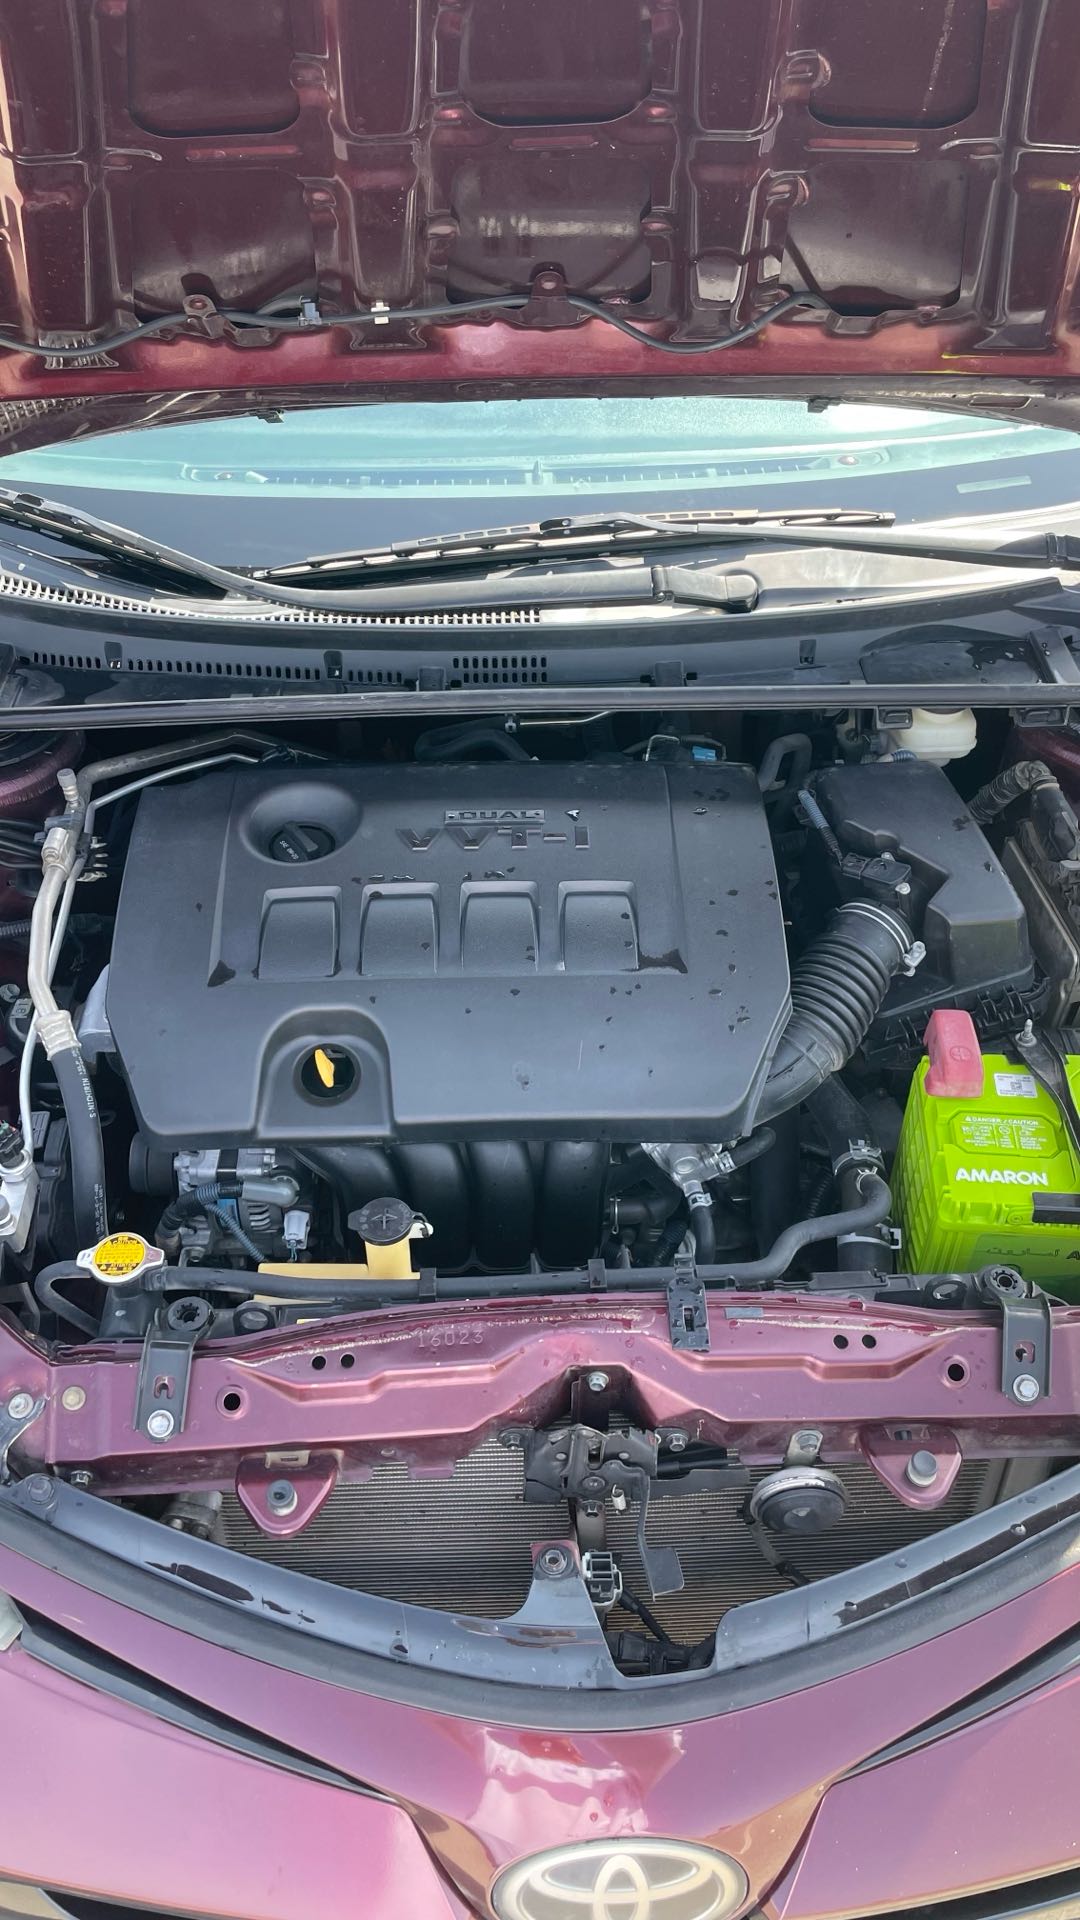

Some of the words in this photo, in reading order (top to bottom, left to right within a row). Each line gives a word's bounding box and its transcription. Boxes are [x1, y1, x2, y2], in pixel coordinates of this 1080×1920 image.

[458, 810, 536, 820] DUAL
[972, 1115, 1001, 1124] DANGER
[1008, 1118, 1039, 1126] CAUTION
[955, 1167, 1049, 1186] AMARON
[418, 1328, 484, 1348] 16023
